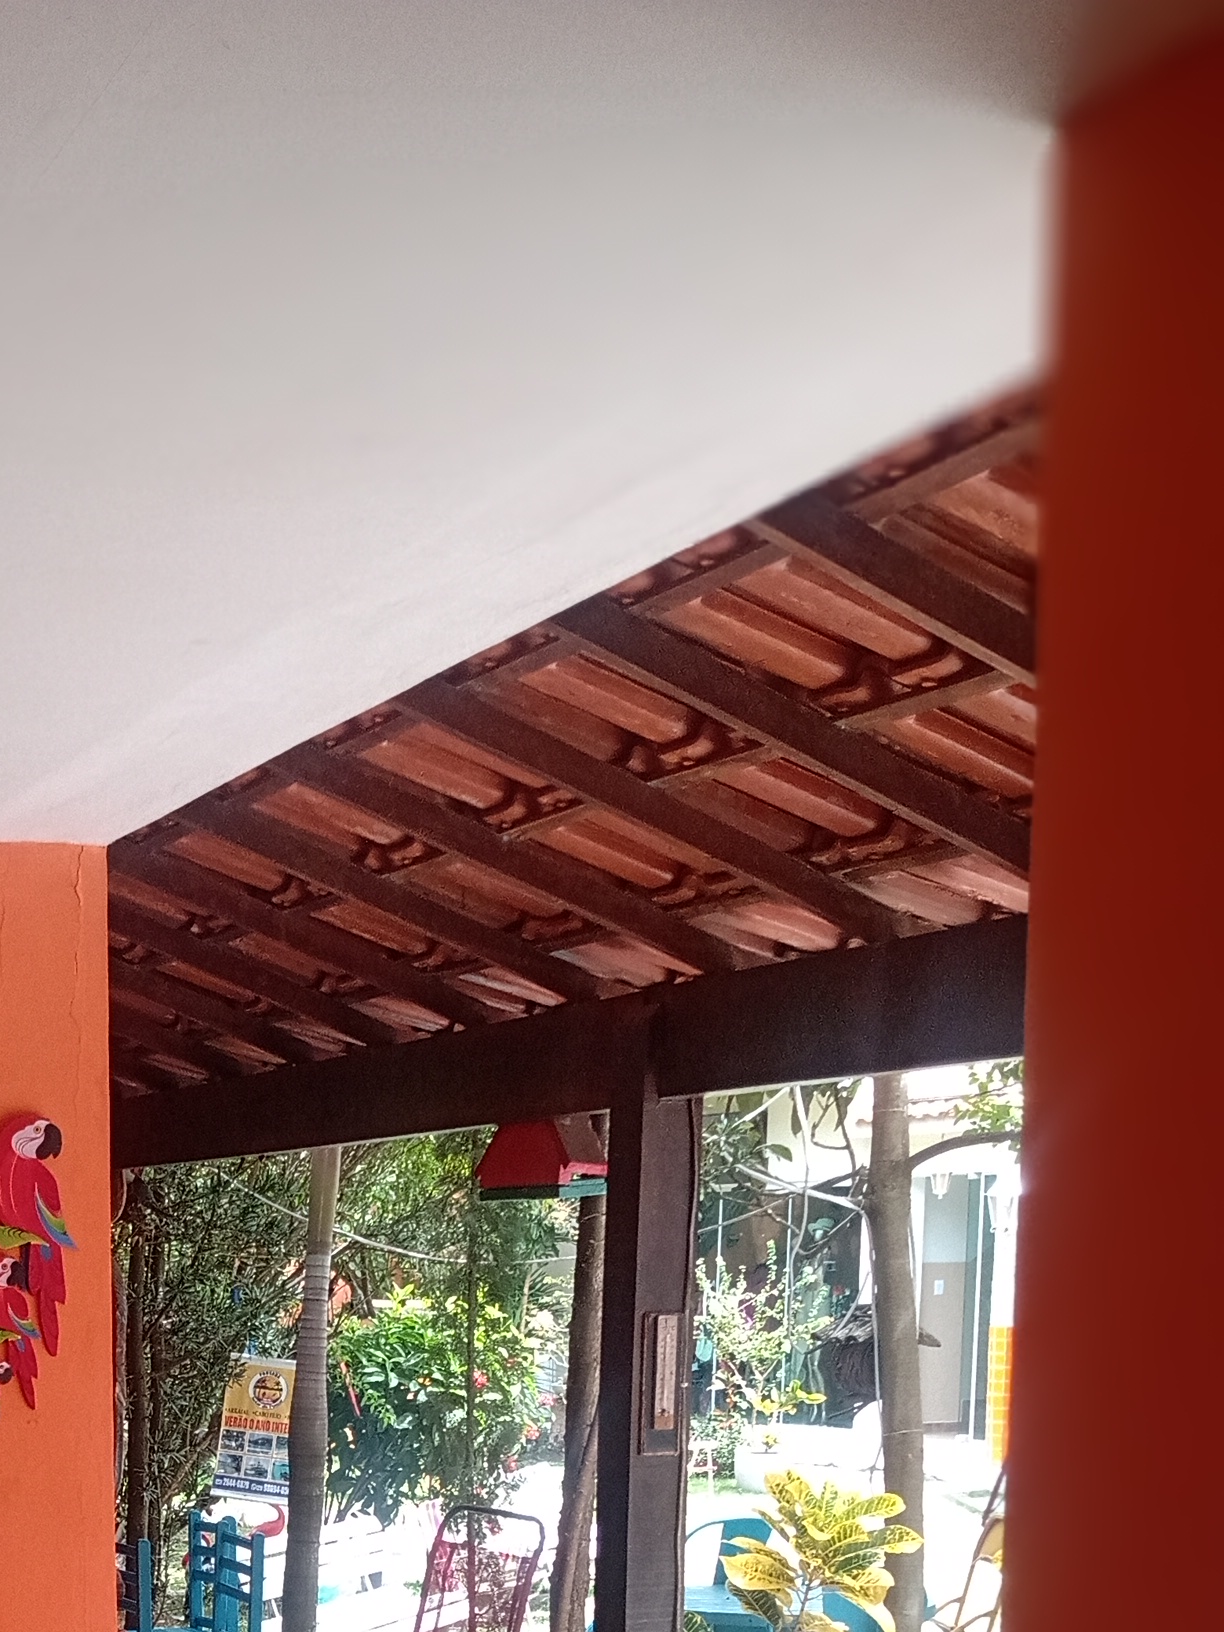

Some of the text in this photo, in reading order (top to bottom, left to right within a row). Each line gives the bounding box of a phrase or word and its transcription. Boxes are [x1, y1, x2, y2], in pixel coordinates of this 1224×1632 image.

[224, 1415, 247, 1429] VERÃO
[248, 1419, 255, 1429] O
[256, 1419, 271, 1432] ANO
